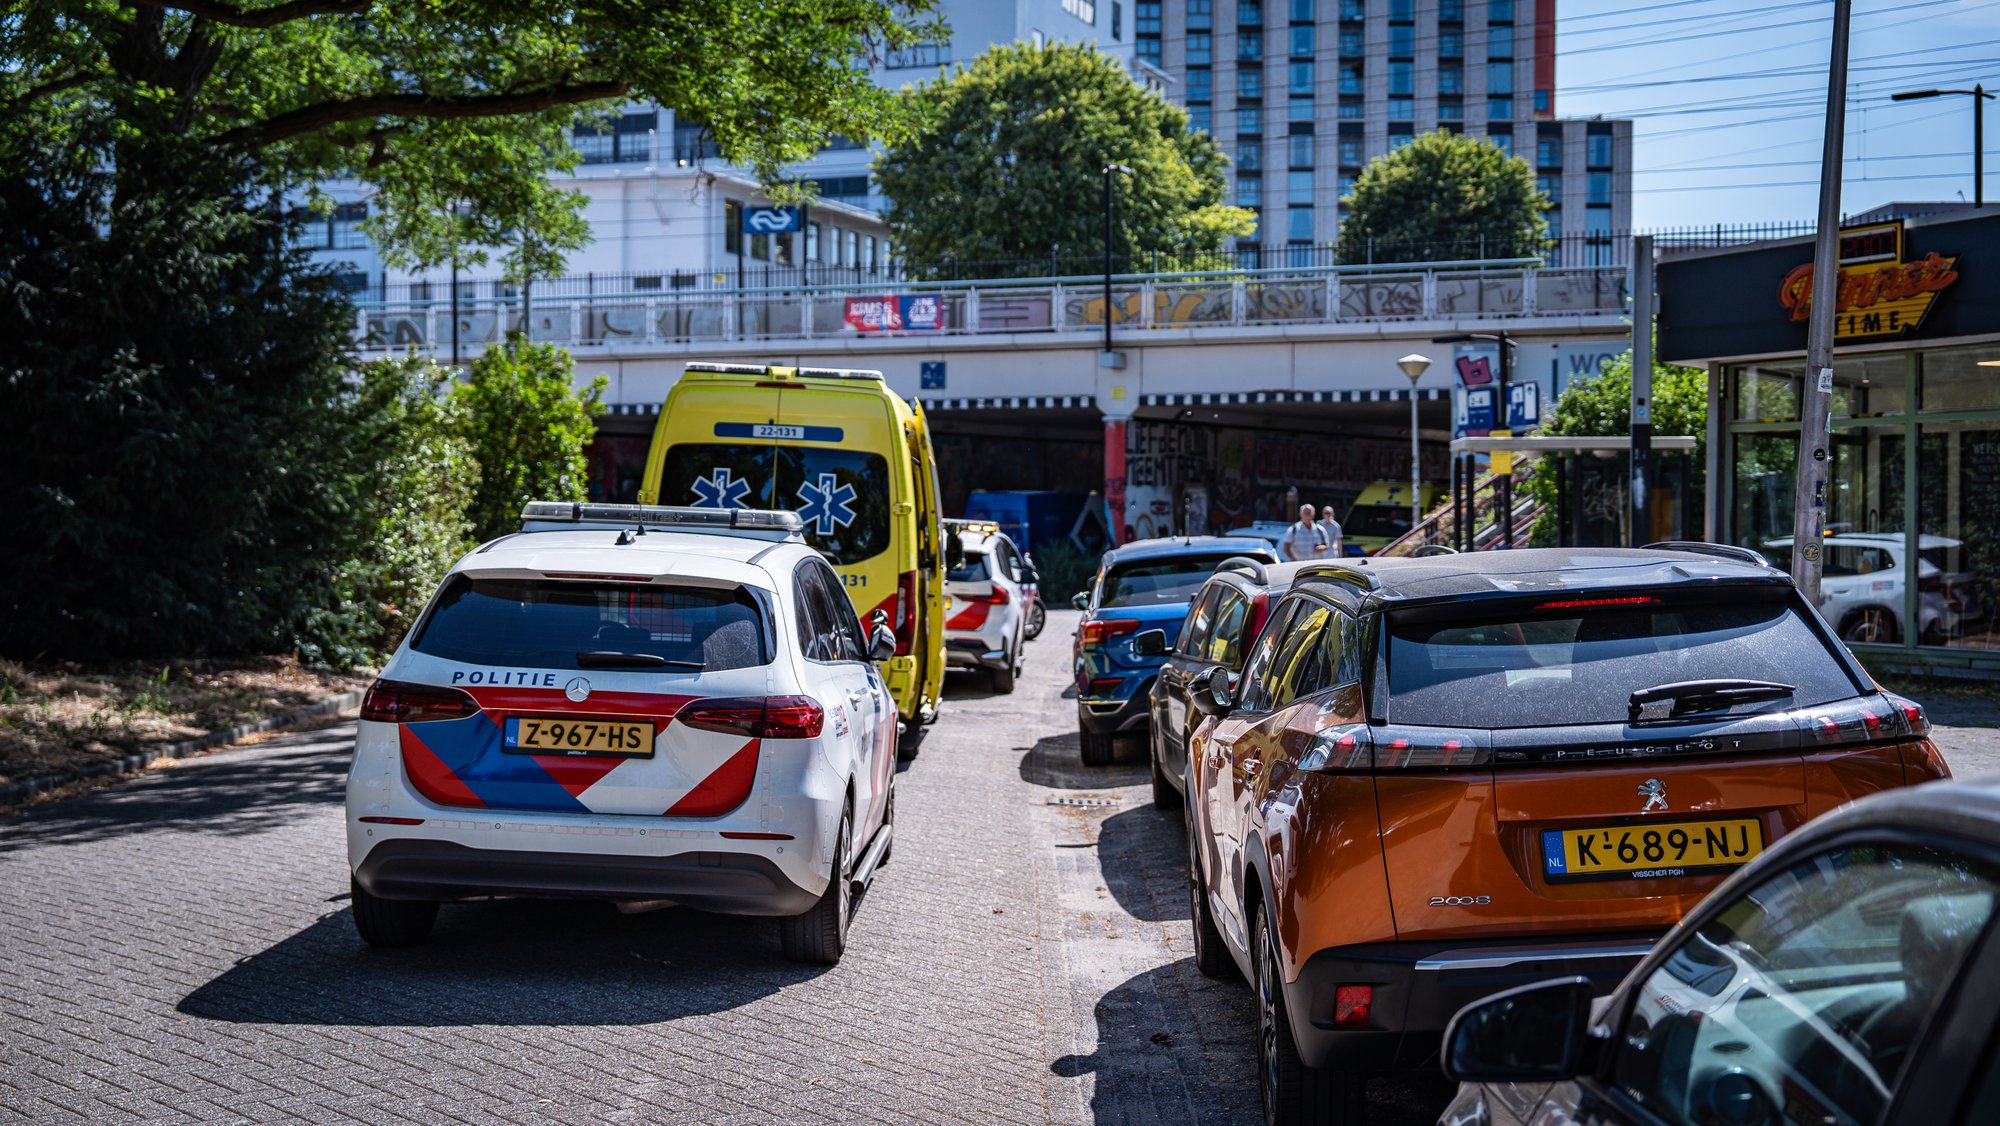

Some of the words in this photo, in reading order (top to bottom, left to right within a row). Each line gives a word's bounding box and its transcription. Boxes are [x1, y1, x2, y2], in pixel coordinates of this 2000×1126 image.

[1835, 311, 1900, 335] TIME
[760, 427, 797, 437] 22-131
[451, 670, 556, 687] POLITIE
[506, 736, 516, 744] NL
[524, 722, 642, 749] Z-967-HS
[1557, 739, 1742, 758] PEUGEOT
[1548, 857, 1564, 868] NL
[1632, 869, 1668, 879] VISSCHER
[1668, 868, 1685, 877] PGH
[1429, 895, 1491, 906] 2008
